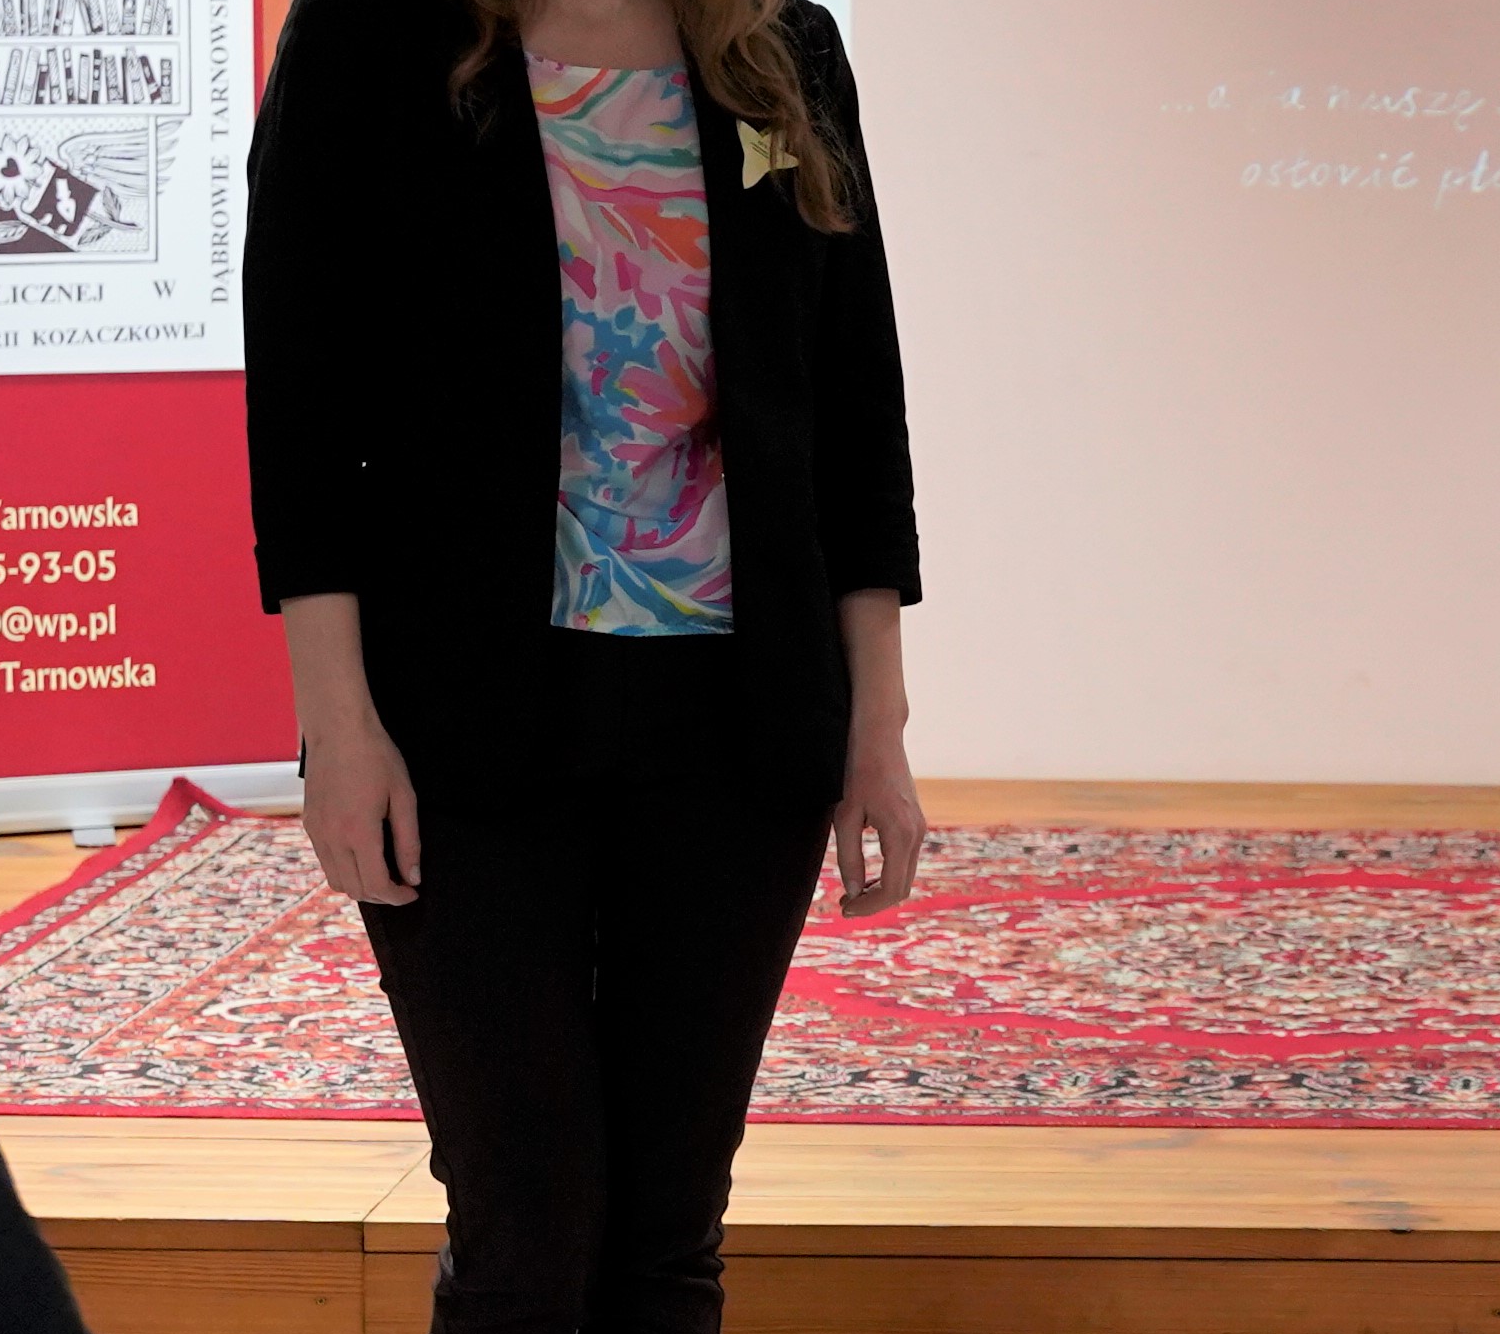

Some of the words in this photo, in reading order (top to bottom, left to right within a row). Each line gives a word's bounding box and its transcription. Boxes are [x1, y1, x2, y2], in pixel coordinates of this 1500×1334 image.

[210, 156, 232, 305] DĄBROWIE
[153, 279, 177, 300] W
[32, 322, 206, 348] KOZACZKOWEJ
